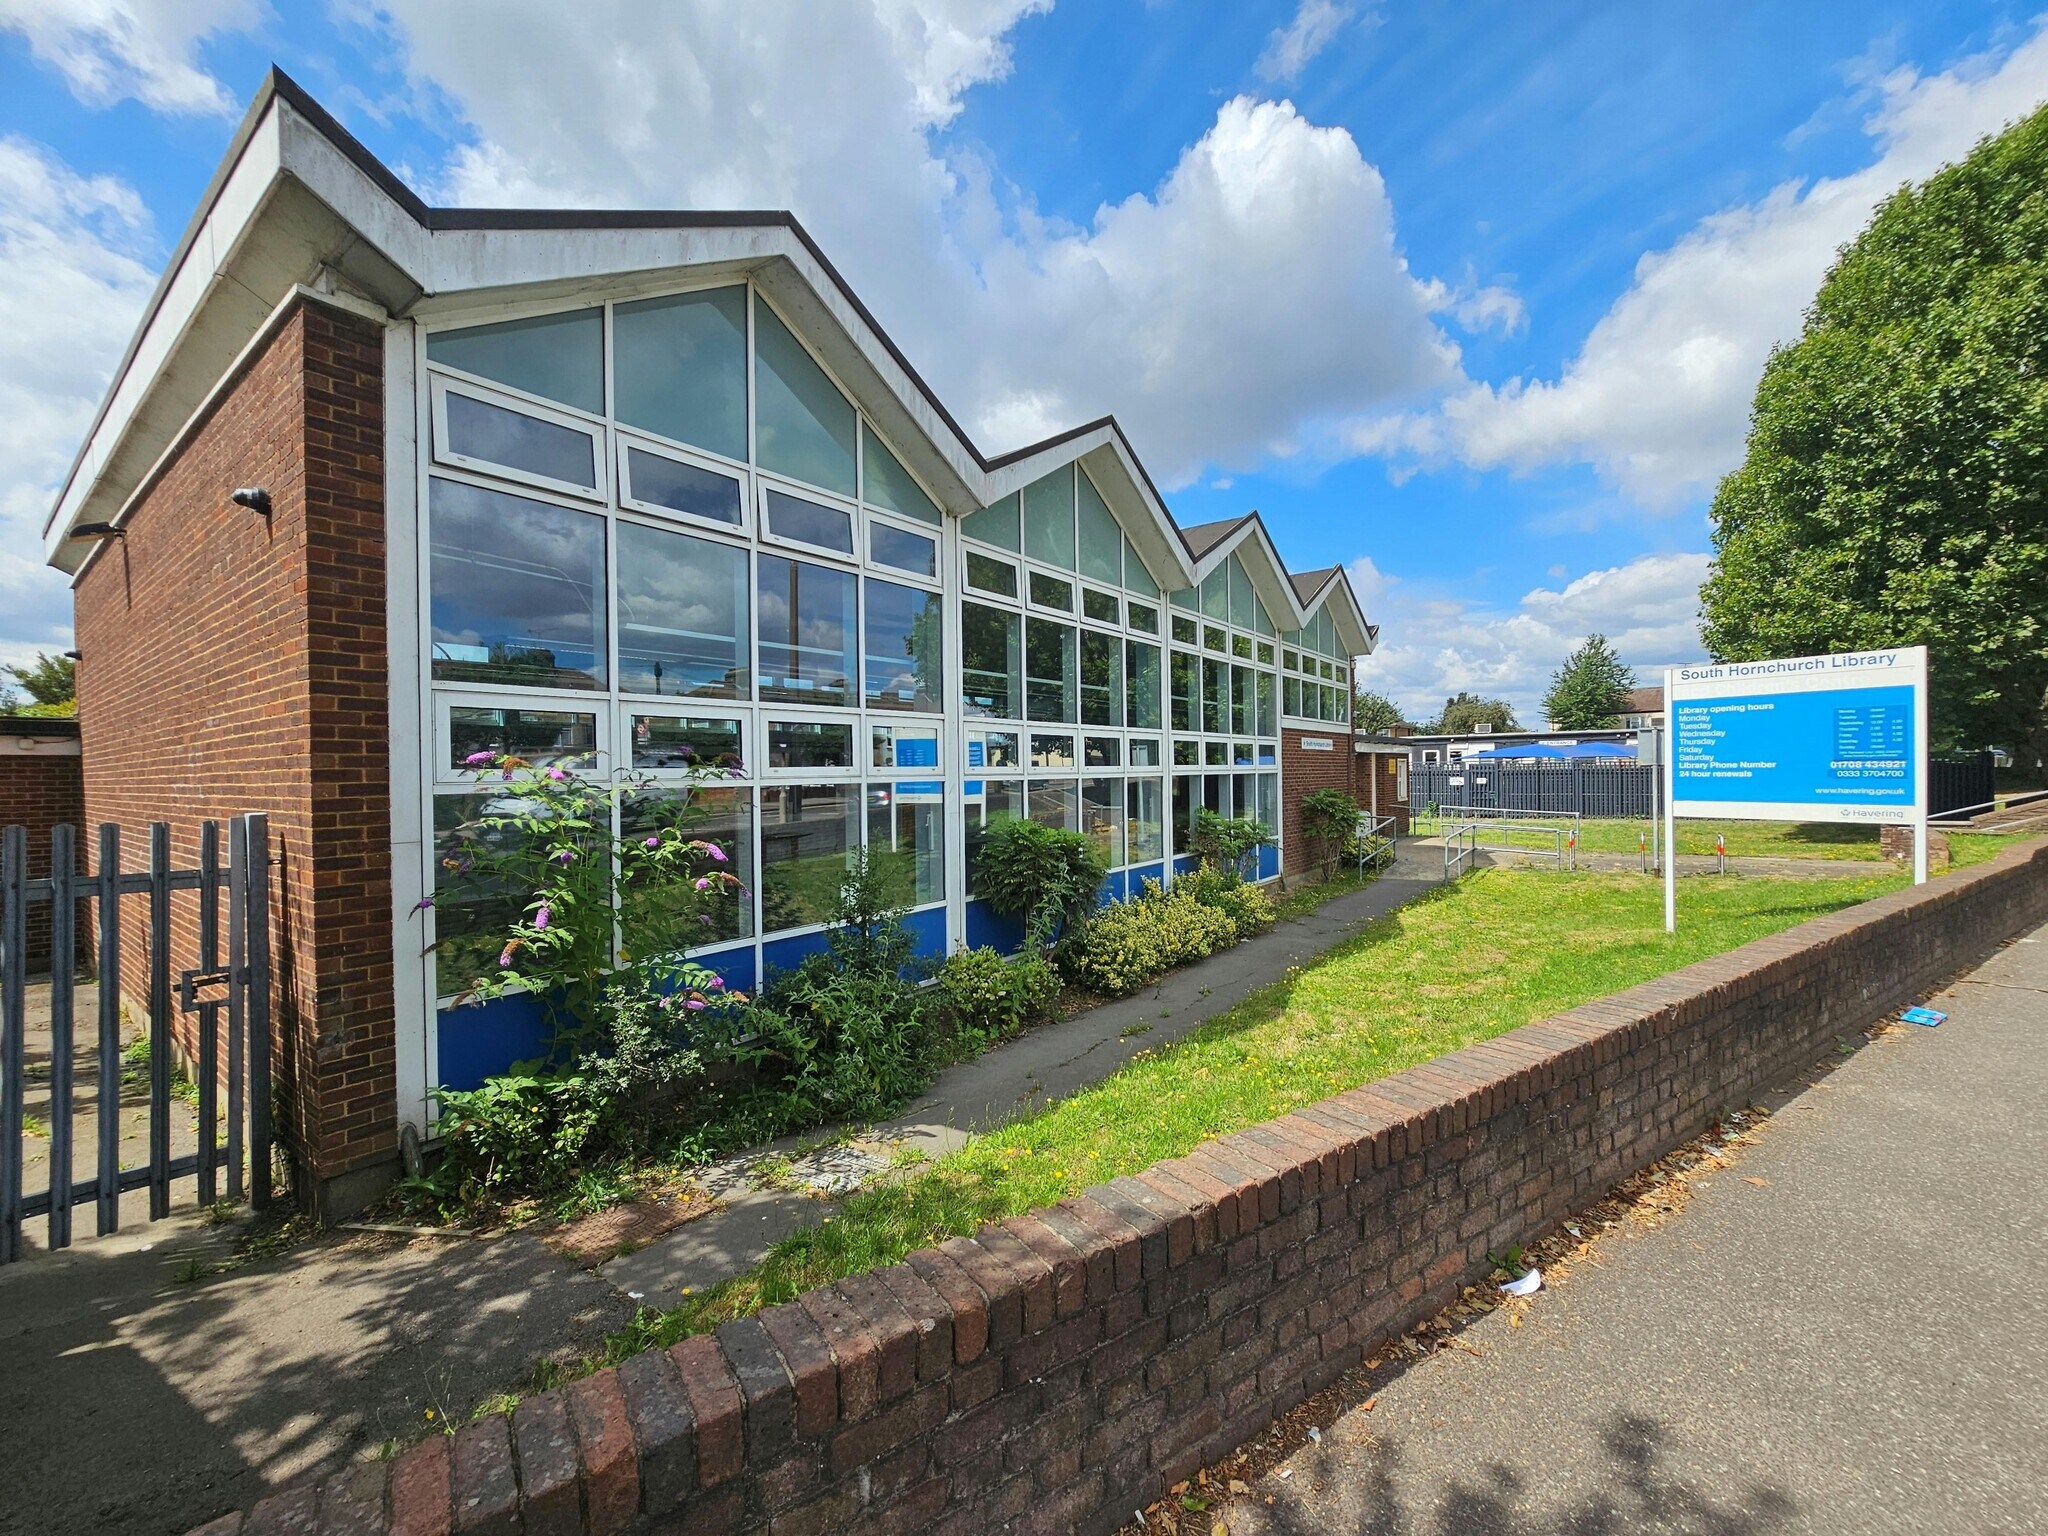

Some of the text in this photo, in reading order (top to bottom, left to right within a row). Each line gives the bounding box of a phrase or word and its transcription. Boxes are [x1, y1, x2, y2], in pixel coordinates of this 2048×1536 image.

[1681, 653, 1897, 681] South Hornchurch Library
[1679, 703, 1775, 715] Library opening hours
[1679, 722, 1712, 730] Tuesday
[1679, 738, 1716, 746] Thursday
[1679, 746, 1703, 754] Friday
[1679, 761, 1709, 770] Library
[1830, 760, 1862, 769] 01708
[1815, 787, 1905, 796] www.havering.gov.uk
[1852, 809, 1904, 819] Havering
